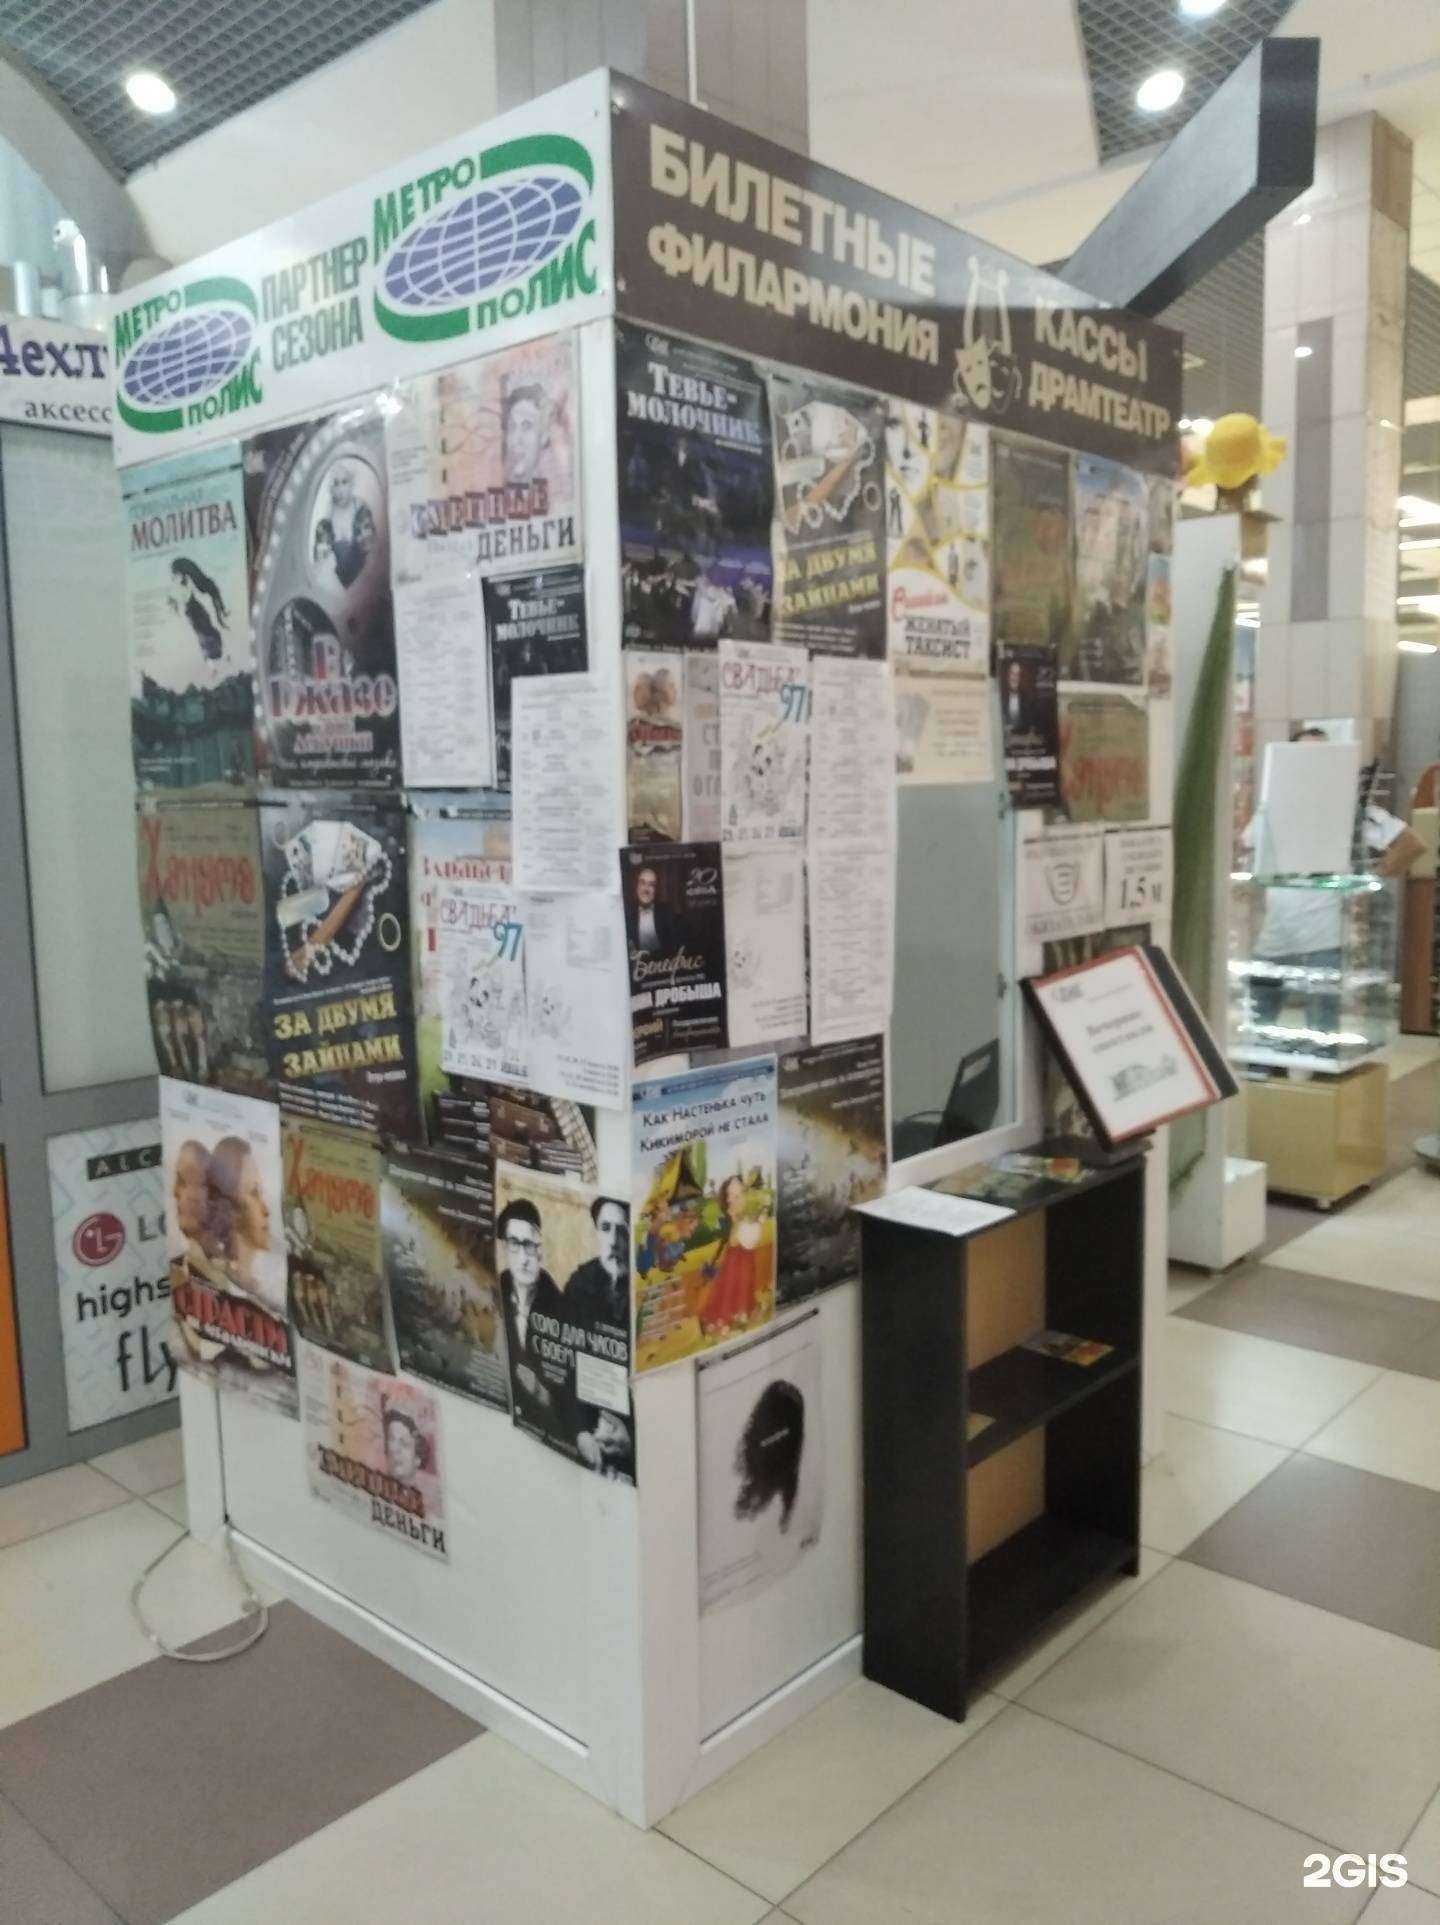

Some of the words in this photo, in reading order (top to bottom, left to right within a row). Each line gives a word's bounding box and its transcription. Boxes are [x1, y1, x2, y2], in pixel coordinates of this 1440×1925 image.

[374, 158, 476, 266] МЕТРО
[262, 236, 369, 322] ПАРТНЕР
[477, 218, 598, 330] ПОЛИС
[648, 123, 937, 298] БИЛЕТНЫЕ
[1034, 298, 1149, 383] КАССЫ
[115, 289, 182, 367] МЕТРО
[272, 296, 364, 373] СЕЗОНА
[647, 221, 940, 366] ФИЛАРМОНИЯ
[1028, 360, 1172, 442] ДРАМТЕАТР
[188, 347, 263, 426] ПОЛИС
[132, 501, 237, 552] МОЛИТВА
[477, 517, 576, 564] ДЕНЬГИ
[274, 1008, 312, 1041] ЗА
[317, 991, 398, 1036] ДВУМЯ
[283, 1034, 404, 1079] ЗАЙЦАМИ
[117, 1326, 177, 1391] fly
[371, 1499, 447, 1553] ДЕНЬГИ
